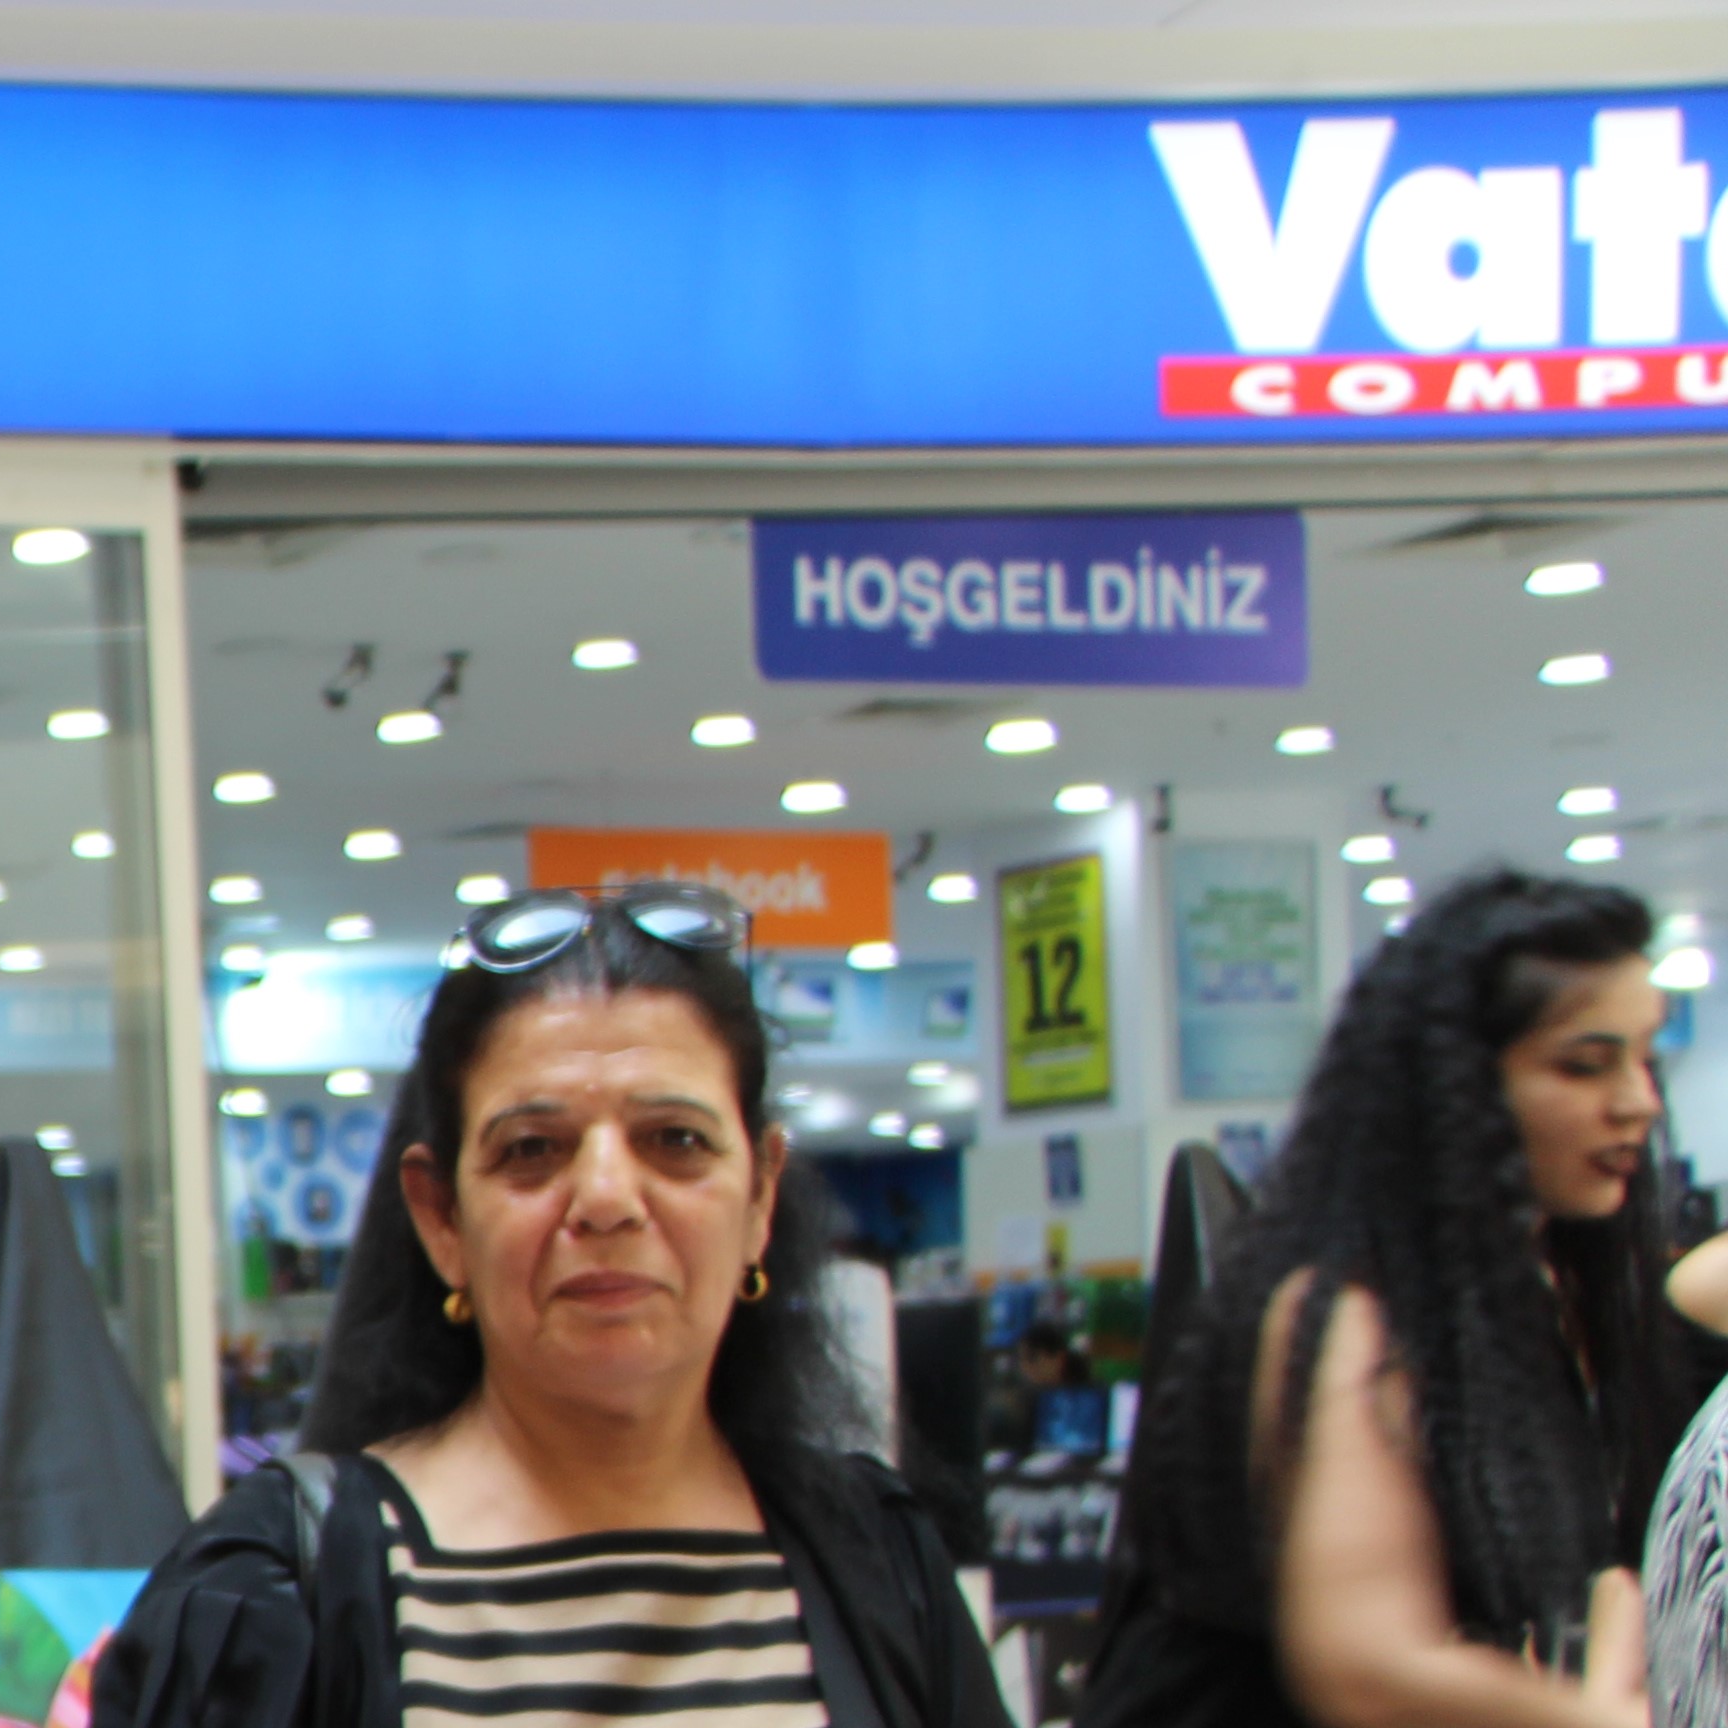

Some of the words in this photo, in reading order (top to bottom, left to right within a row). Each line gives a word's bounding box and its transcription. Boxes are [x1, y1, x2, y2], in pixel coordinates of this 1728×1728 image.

[1148, 108, 1728, 354] Vat
[794, 544, 1268, 649] HOŞGELDİNİZ
[1020, 935, 1086, 1032] 12
